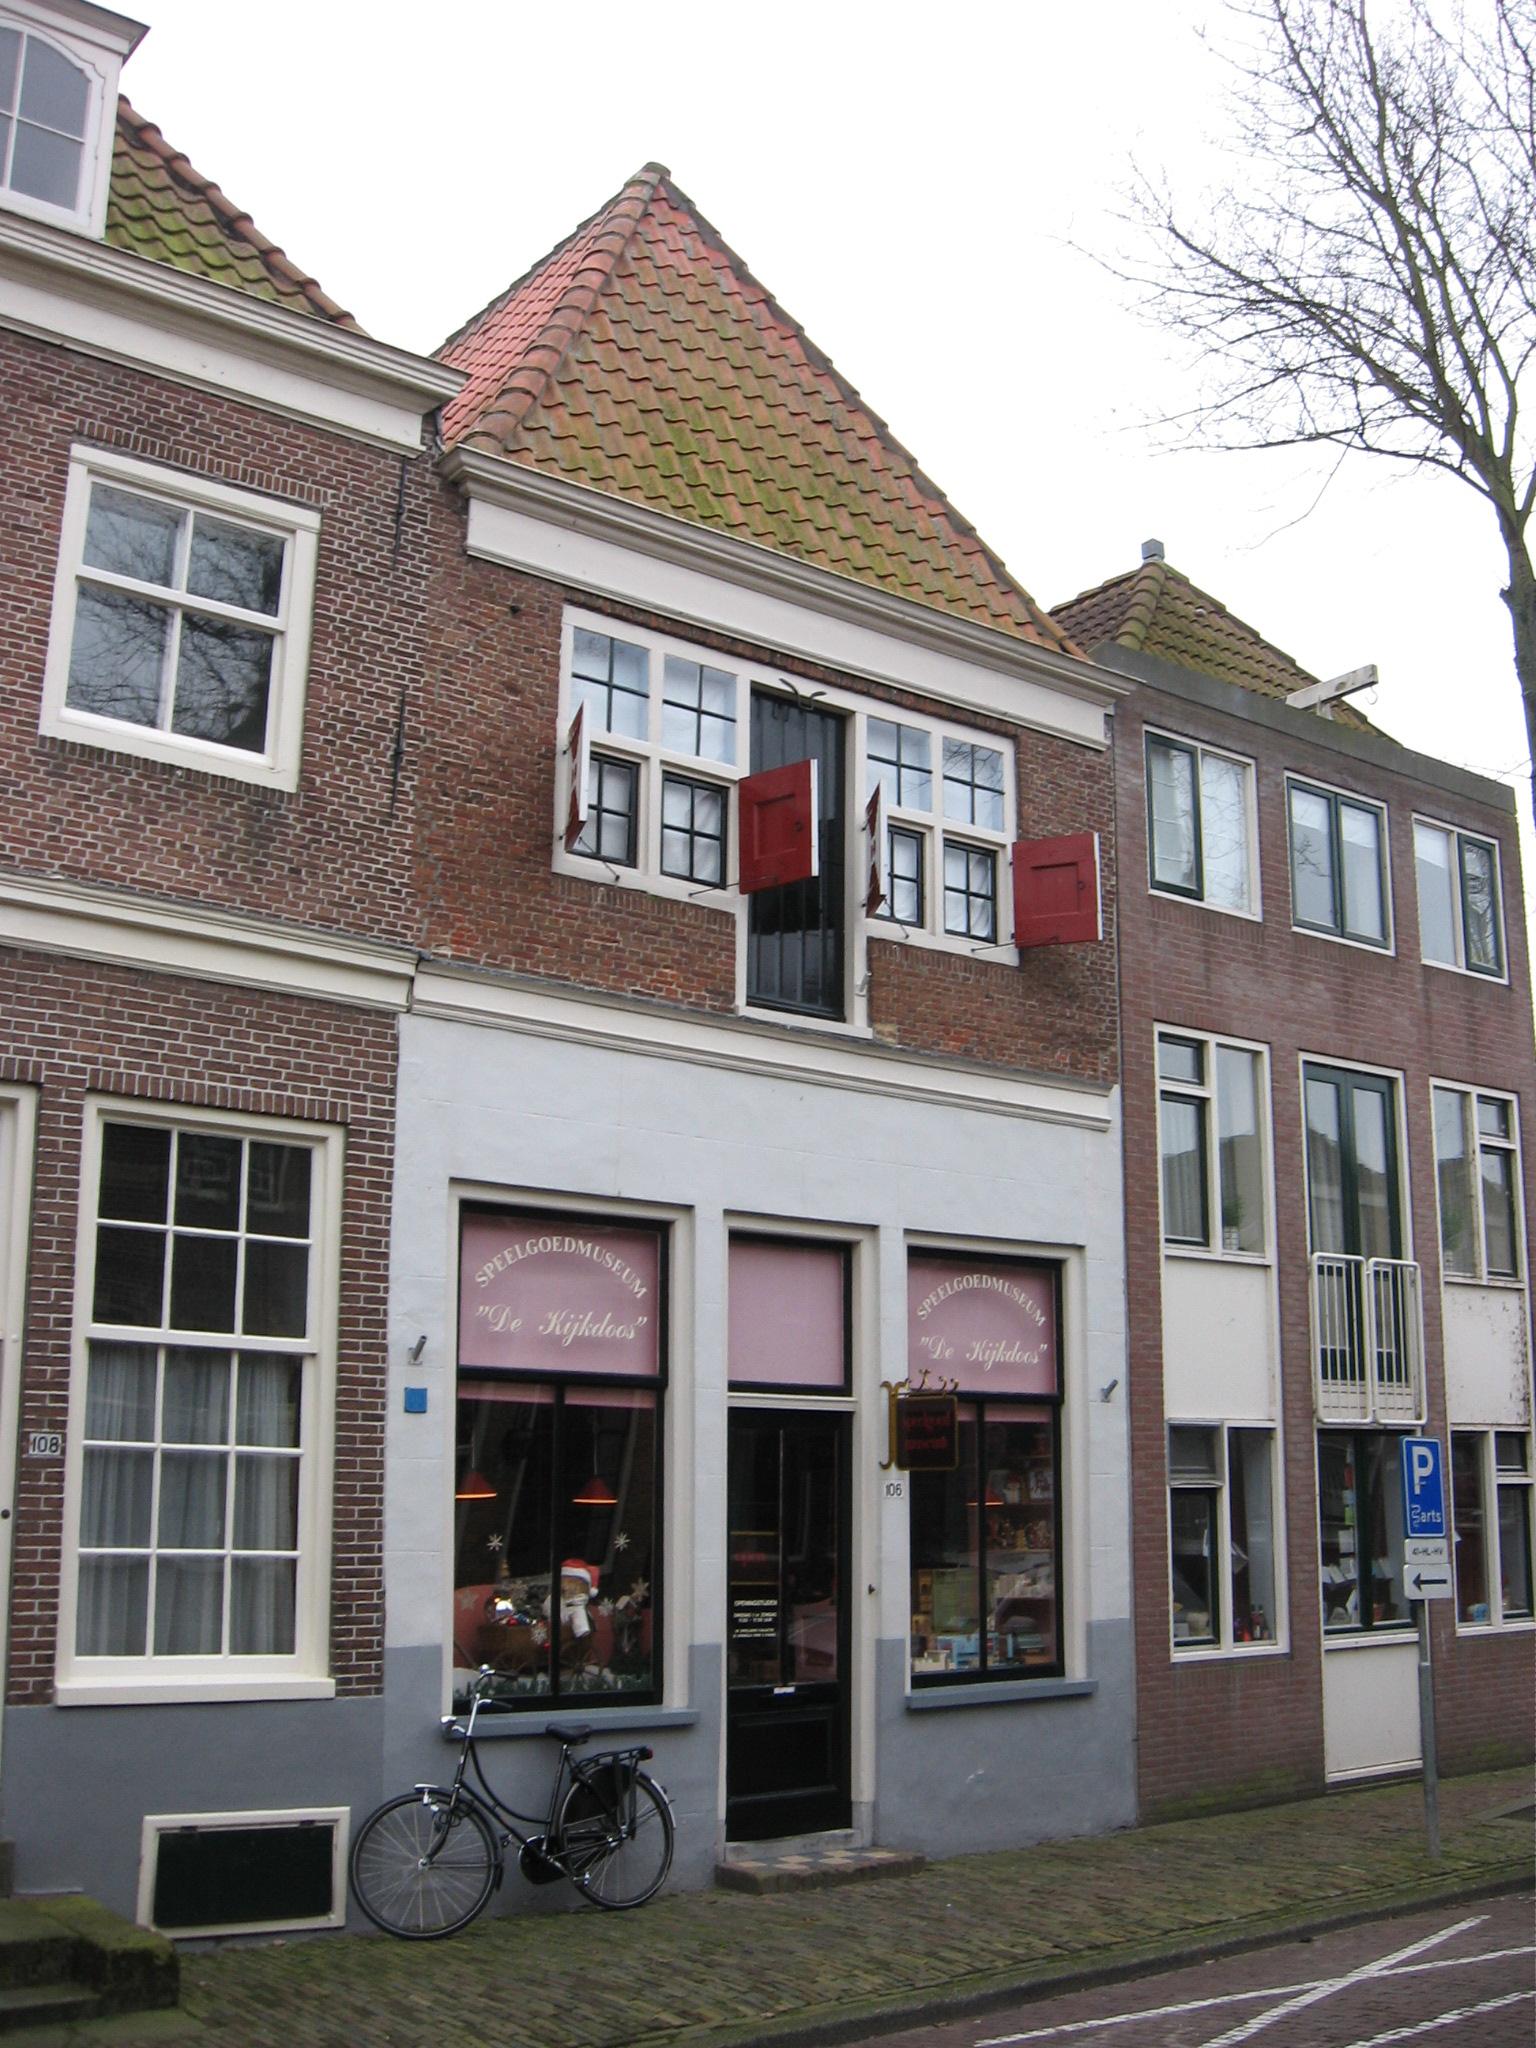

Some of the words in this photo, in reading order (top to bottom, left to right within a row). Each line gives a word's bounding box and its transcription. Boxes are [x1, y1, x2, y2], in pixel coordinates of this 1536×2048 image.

[475, 1236, 647, 1299] SPEELGOEDMUSEUM
[917, 1274, 1046, 1327] SPEELGOEDMUSEUM
[31, 1436, 59, 1453] 108
[885, 1483, 902, 1497] 106
[1411, 1446, 1434, 1495] P
